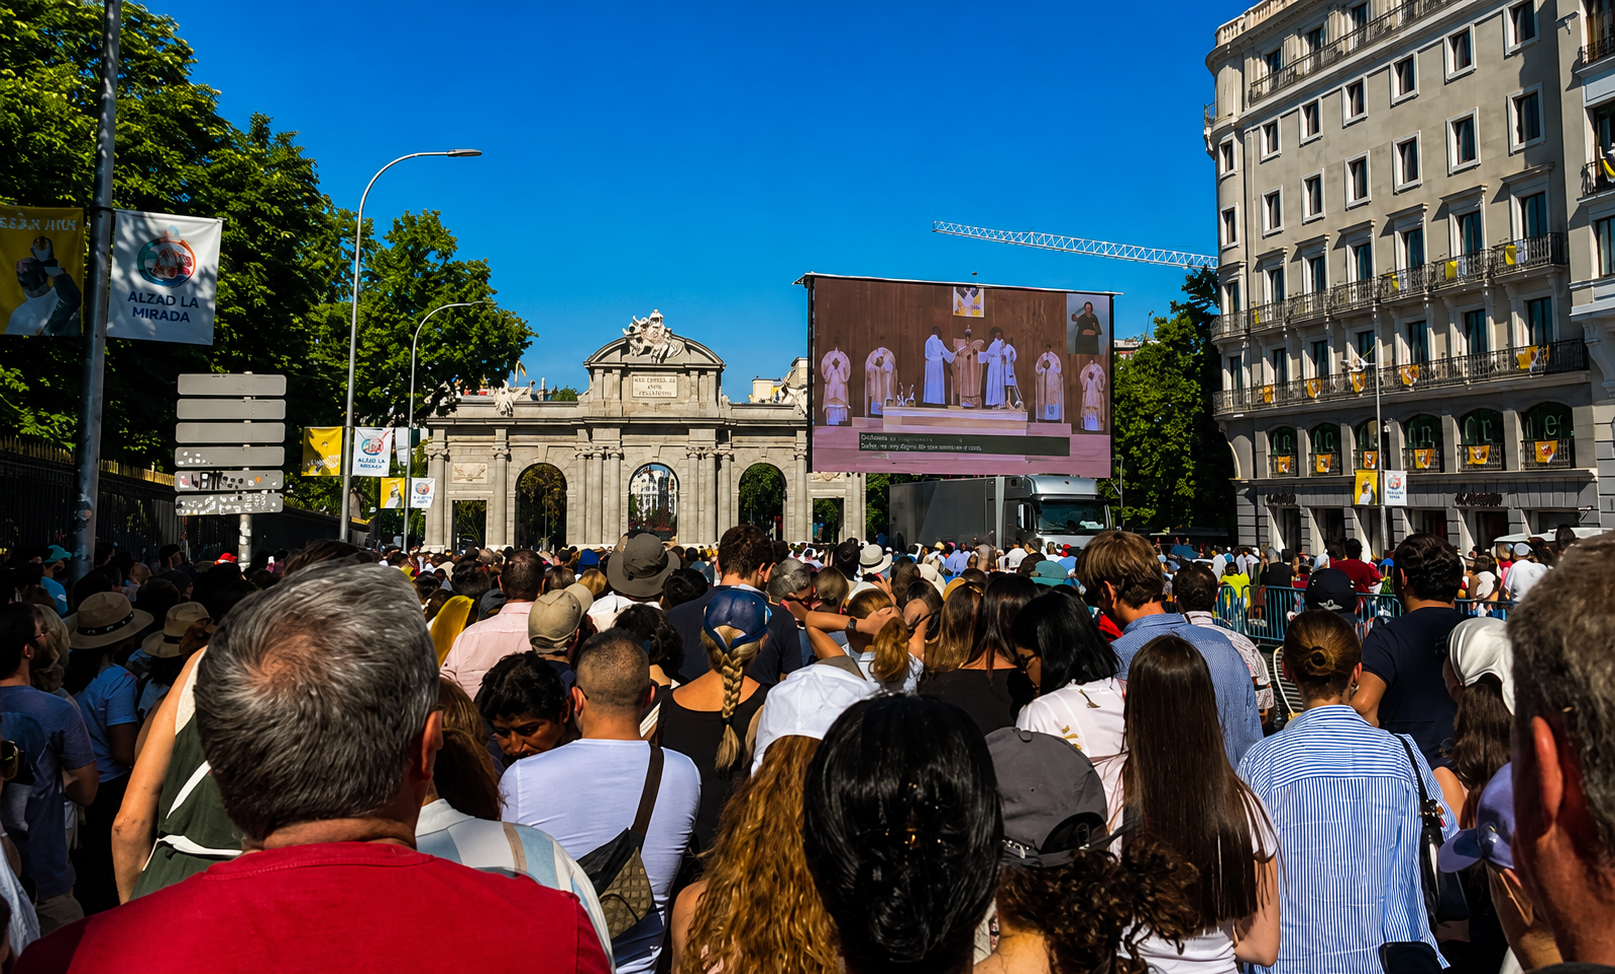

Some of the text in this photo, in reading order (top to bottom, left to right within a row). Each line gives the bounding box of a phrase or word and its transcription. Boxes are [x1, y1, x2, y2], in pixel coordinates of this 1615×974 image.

[127, 291, 200, 309] ALZAD LA
[132, 306, 191, 323] MIRADA
